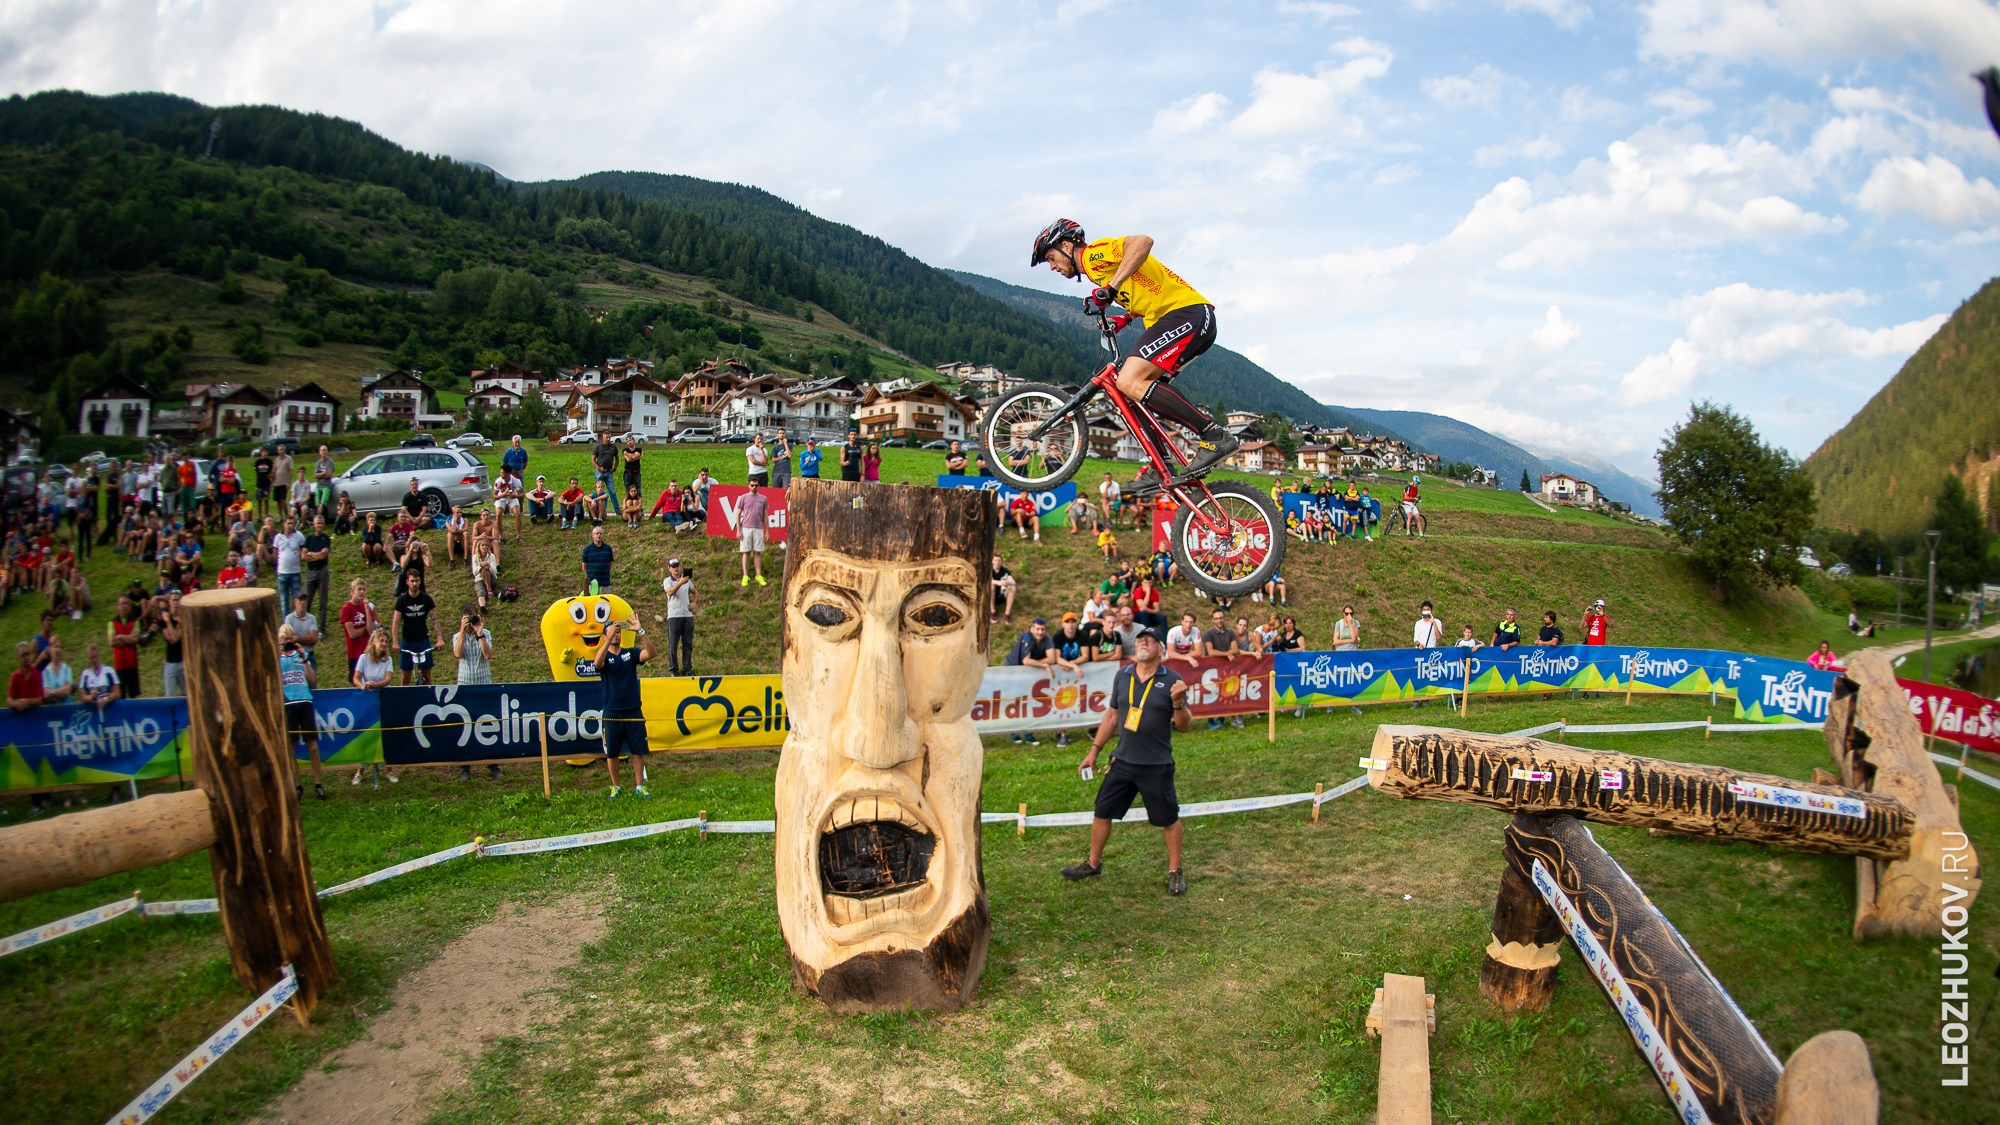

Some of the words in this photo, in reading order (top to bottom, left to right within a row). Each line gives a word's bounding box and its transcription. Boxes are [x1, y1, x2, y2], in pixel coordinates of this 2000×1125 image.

[1298, 661, 1373, 689] TRENTINO
[1519, 655, 1578, 677] TRENTINO
[1620, 655, 1688, 678] TRENTINO
[970, 690, 1001, 721] al
[1005, 695, 1028, 719] di
[1032, 678, 1106, 718] Sole
[1201, 668, 1262, 704] Sole
[48, 717, 160, 760] TRENTINO
